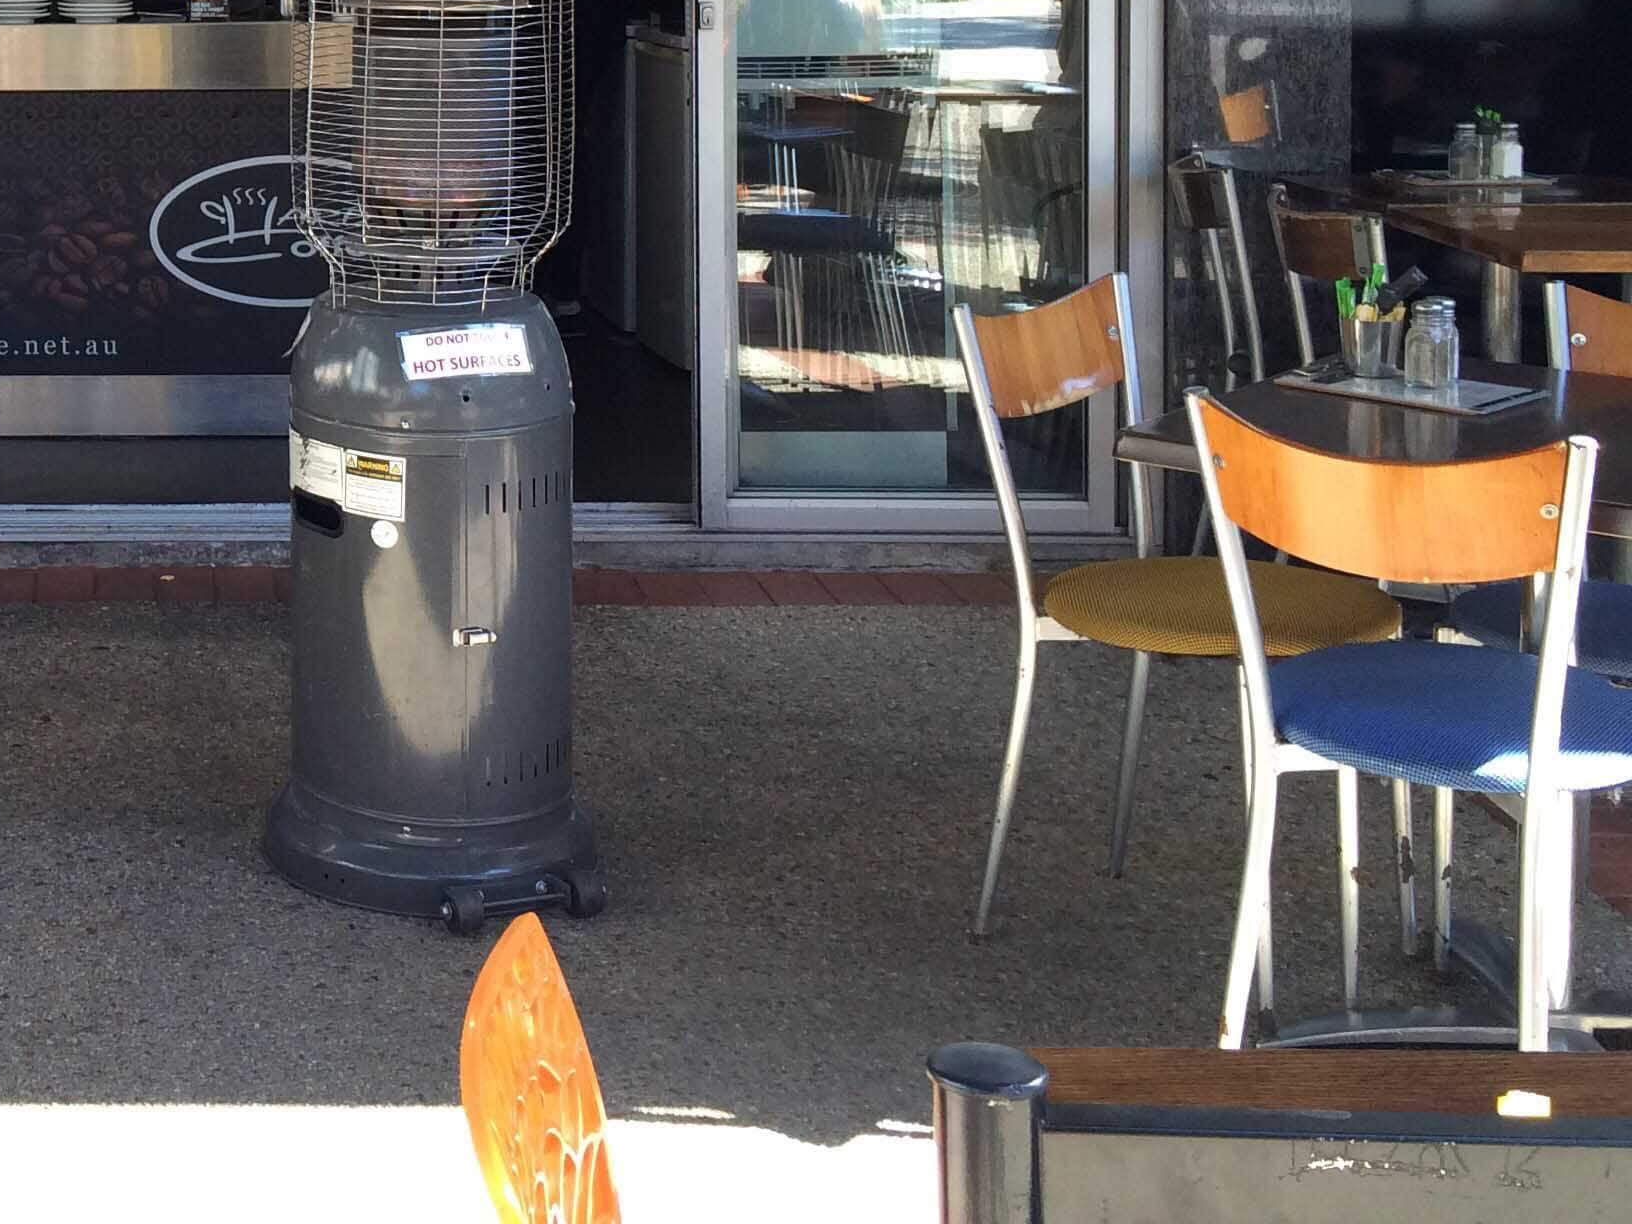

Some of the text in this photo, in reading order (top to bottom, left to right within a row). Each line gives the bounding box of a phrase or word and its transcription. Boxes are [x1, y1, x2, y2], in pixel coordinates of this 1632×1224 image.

[425, 335, 444, 346] DO
[446, 333, 470, 344] NOT
[413, 356, 446, 374] HOT
